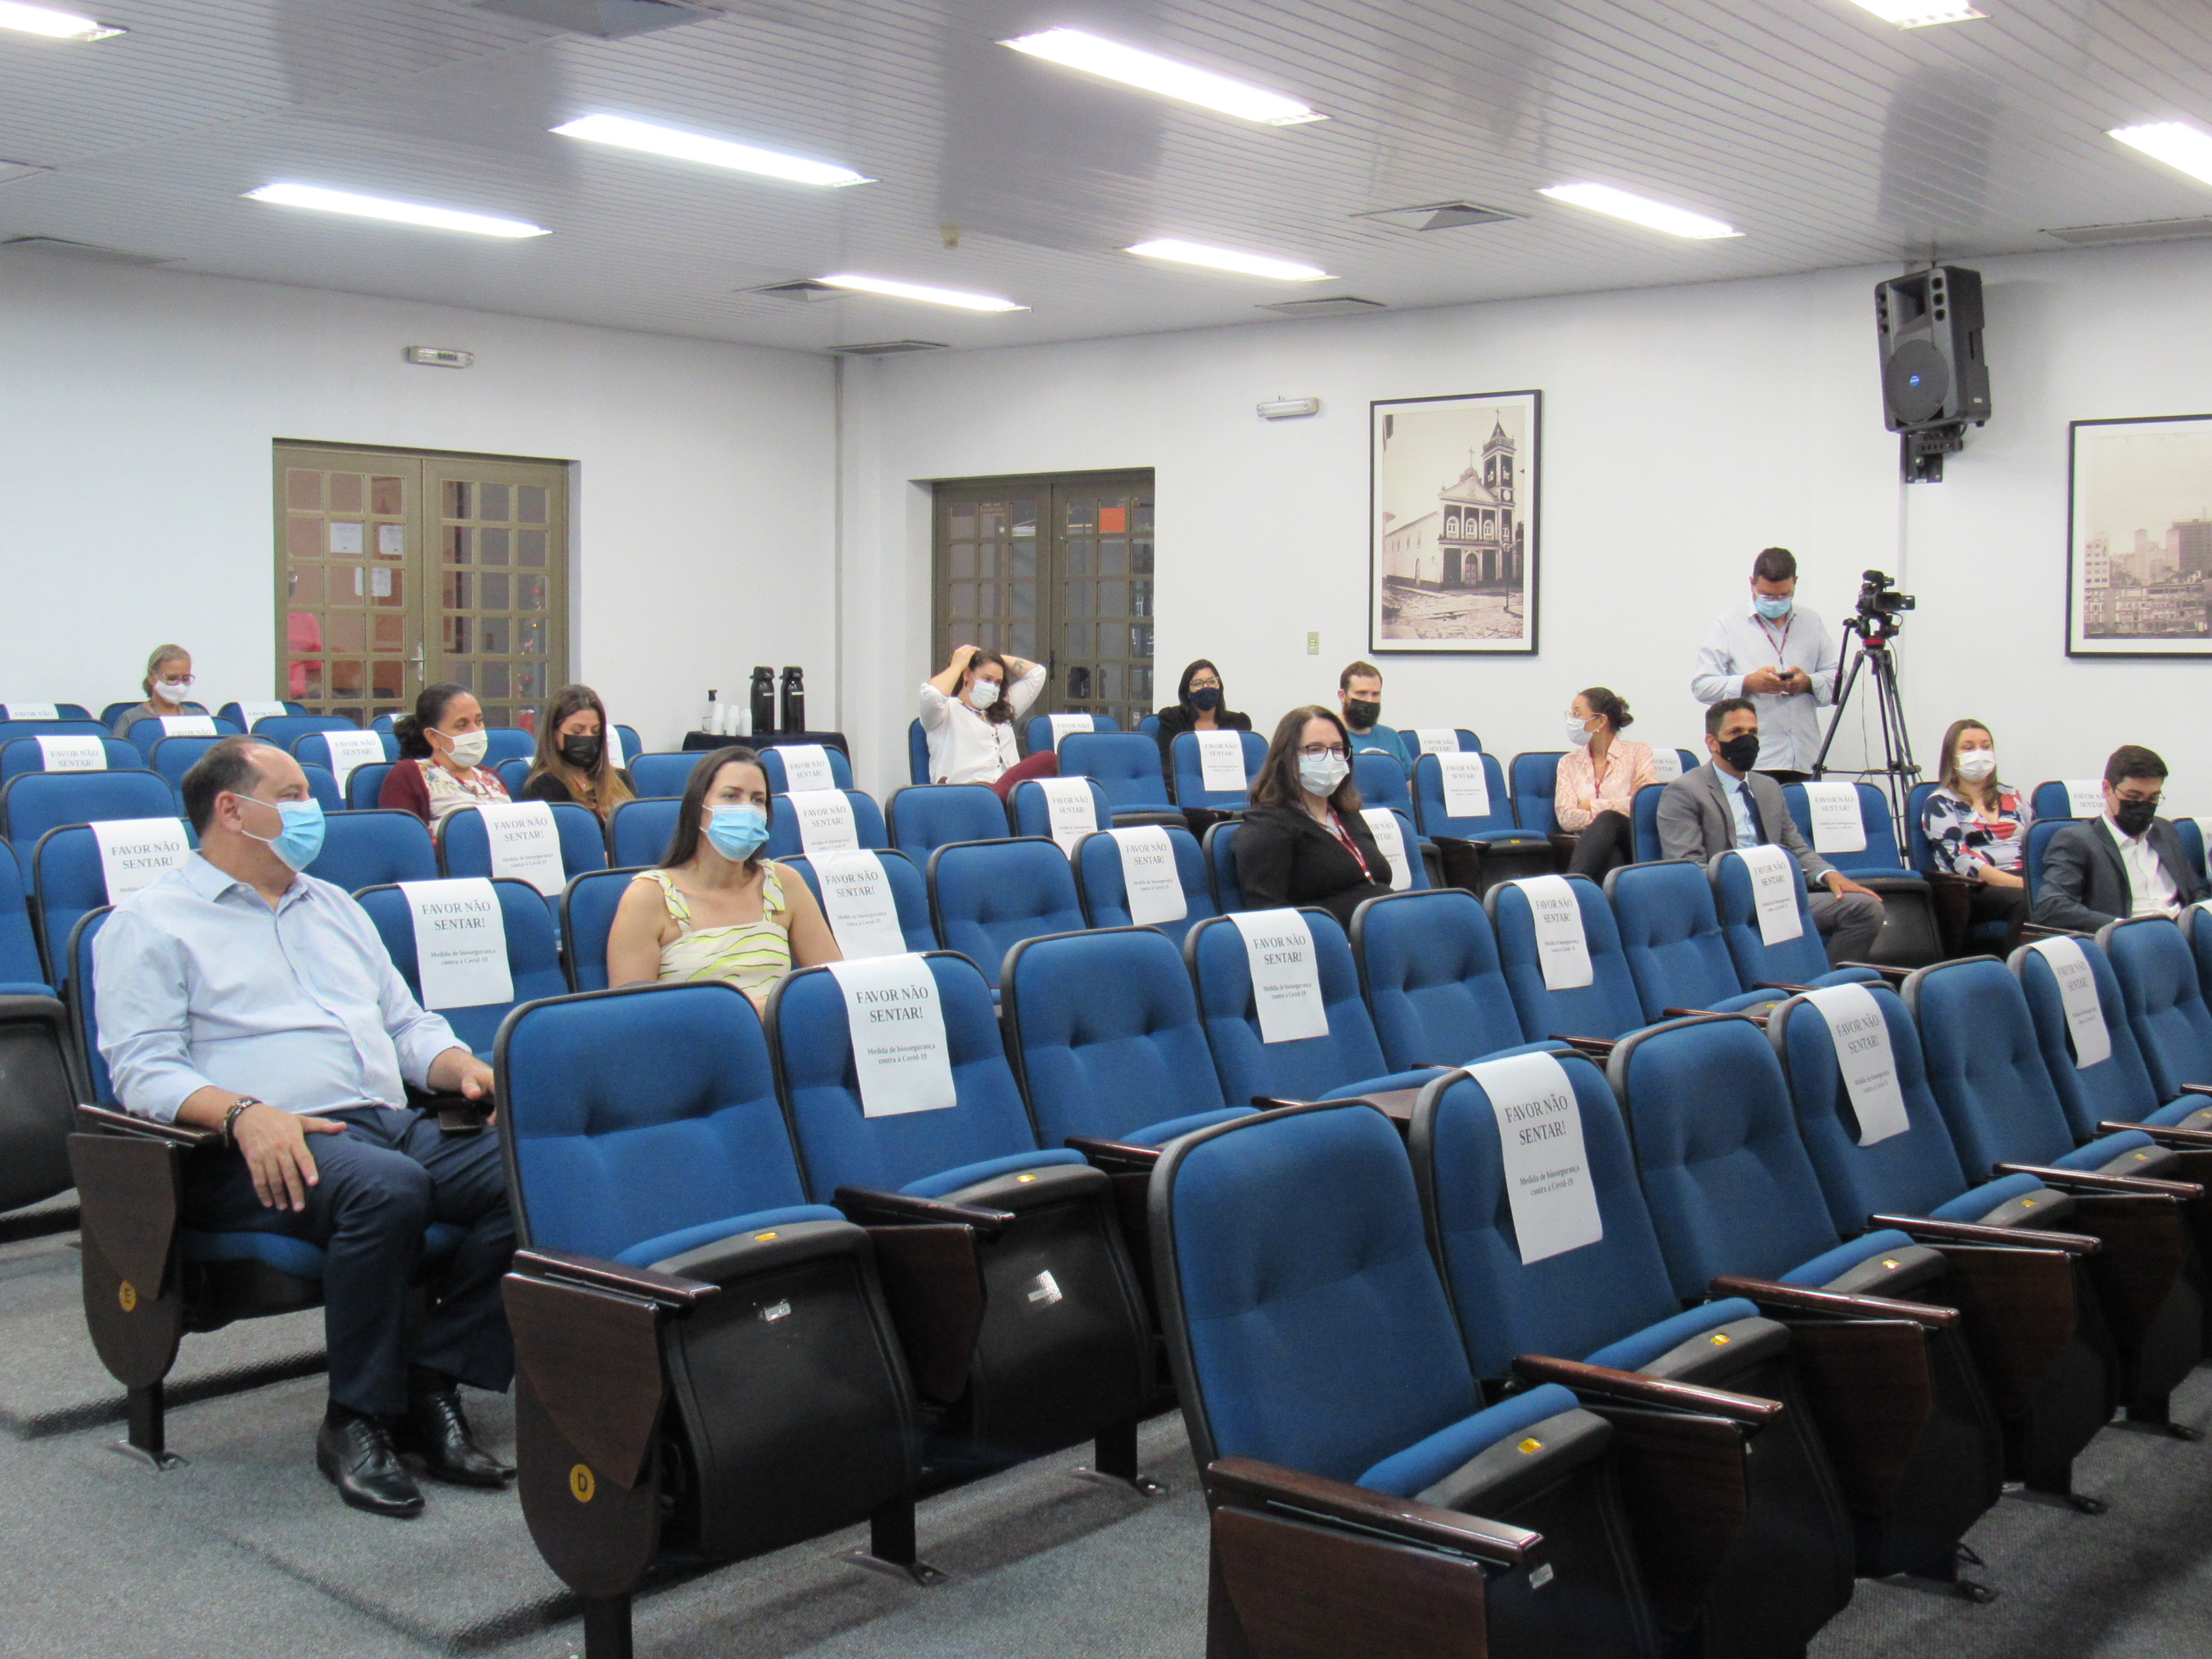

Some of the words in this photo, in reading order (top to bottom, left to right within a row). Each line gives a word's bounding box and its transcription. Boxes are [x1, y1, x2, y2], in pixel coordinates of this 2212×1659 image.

[797, 770, 822, 779] SENTAR!
[803, 809, 827, 817] FAVOR
[494, 820, 525, 830] FAVOR
[527, 817, 548, 827] NÃO
[812, 817, 843, 827] SENTAR!
[1380, 821, 1393, 829] NÃO
[504, 831, 544, 842] SENTAR!
[111, 844, 150, 856] FAVOR
[154, 841, 180, 853] NÃO
[1125, 845, 1149, 853] FAVOR
[1151, 842, 1166, 853] NÃO
[123, 857, 173, 869] SENTAR!
[1134, 855, 1164, 865] SENTAR!
[1753, 865, 1773, 875] FAVOR
[1773, 861, 1786, 872] NÃO
[825, 874, 855, 884] FAVOR
[857, 871, 878, 882] NÃO
[1761, 875, 1785, 886] SENTAR!
[836, 886, 874, 897] SENTAR!
[422, 903, 462, 915] FAVOR
[464, 899, 491, 912] NÃO
[1535, 899, 1556, 909] FAVOR
[1556, 897, 1572, 908] NÃO
[434, 918, 485, 930] SENTAR!
[1543, 913, 1571, 923] SENTAR!
[1253, 938, 1284, 949] FAVOR
[1286, 934, 1306, 945] NÃO
[1264, 951, 1302, 964] SENTAR!
[856, 989, 899, 1004] FAVOR
[901, 985, 928, 1000] NÃO
[869, 1006, 923, 1023] SENTAR!
[1836, 1020, 1864, 1037] FAVOR
[1862, 1013, 1879, 1030] NÃO
[867, 1047, 888, 1055] Medida
[1848, 1035, 1879, 1054] SENTAR!
[1504, 1101, 1543, 1123] FAVOR
[1543, 1094, 1568, 1114] NÃO
[1519, 1120, 1567, 1145] SENTAR!
[125, 1288, 133, 1303] E
[577, 1473, 588, 1492] D
